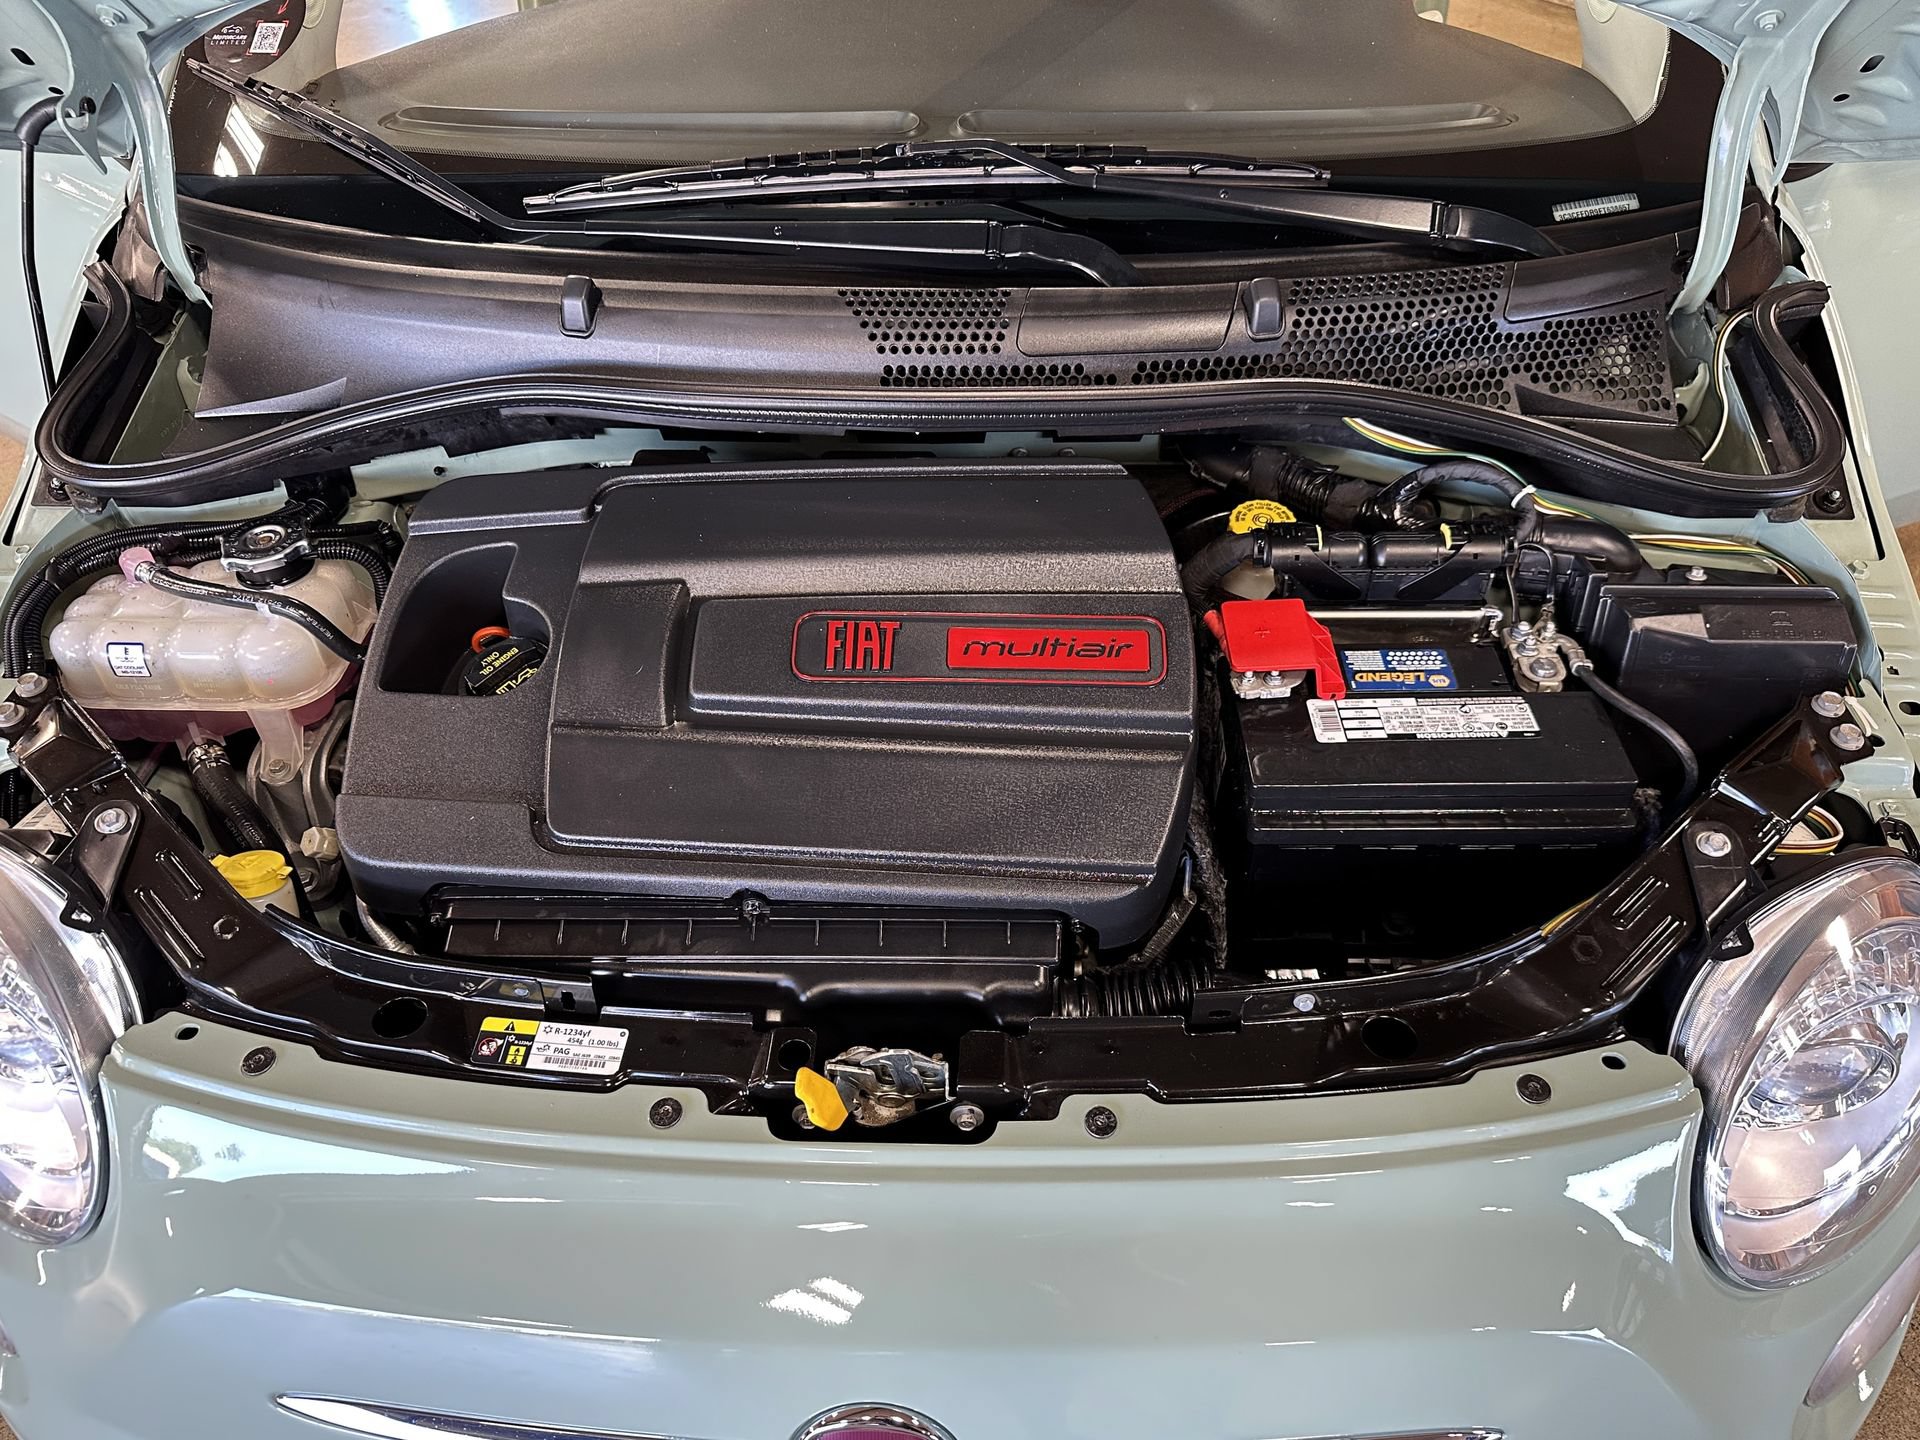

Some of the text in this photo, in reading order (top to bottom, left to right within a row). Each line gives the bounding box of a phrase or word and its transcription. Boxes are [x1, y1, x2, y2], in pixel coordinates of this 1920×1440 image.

[824, 620, 1134, 673] FIAT multiair
[479, 647, 519, 676] ENGINE OIL
[480, 651, 500, 667] ONLY
[1354, 671, 1425, 683] LEGEND
[1416, 731, 1499, 739] DANGER/POISON
[554, 1027, 592, 1038] R-1234yf
[567, 1037, 584, 1046] 454g
[606, 1040, 619, 1048] lbs)
[553, 1047, 570, 1055] PAG
